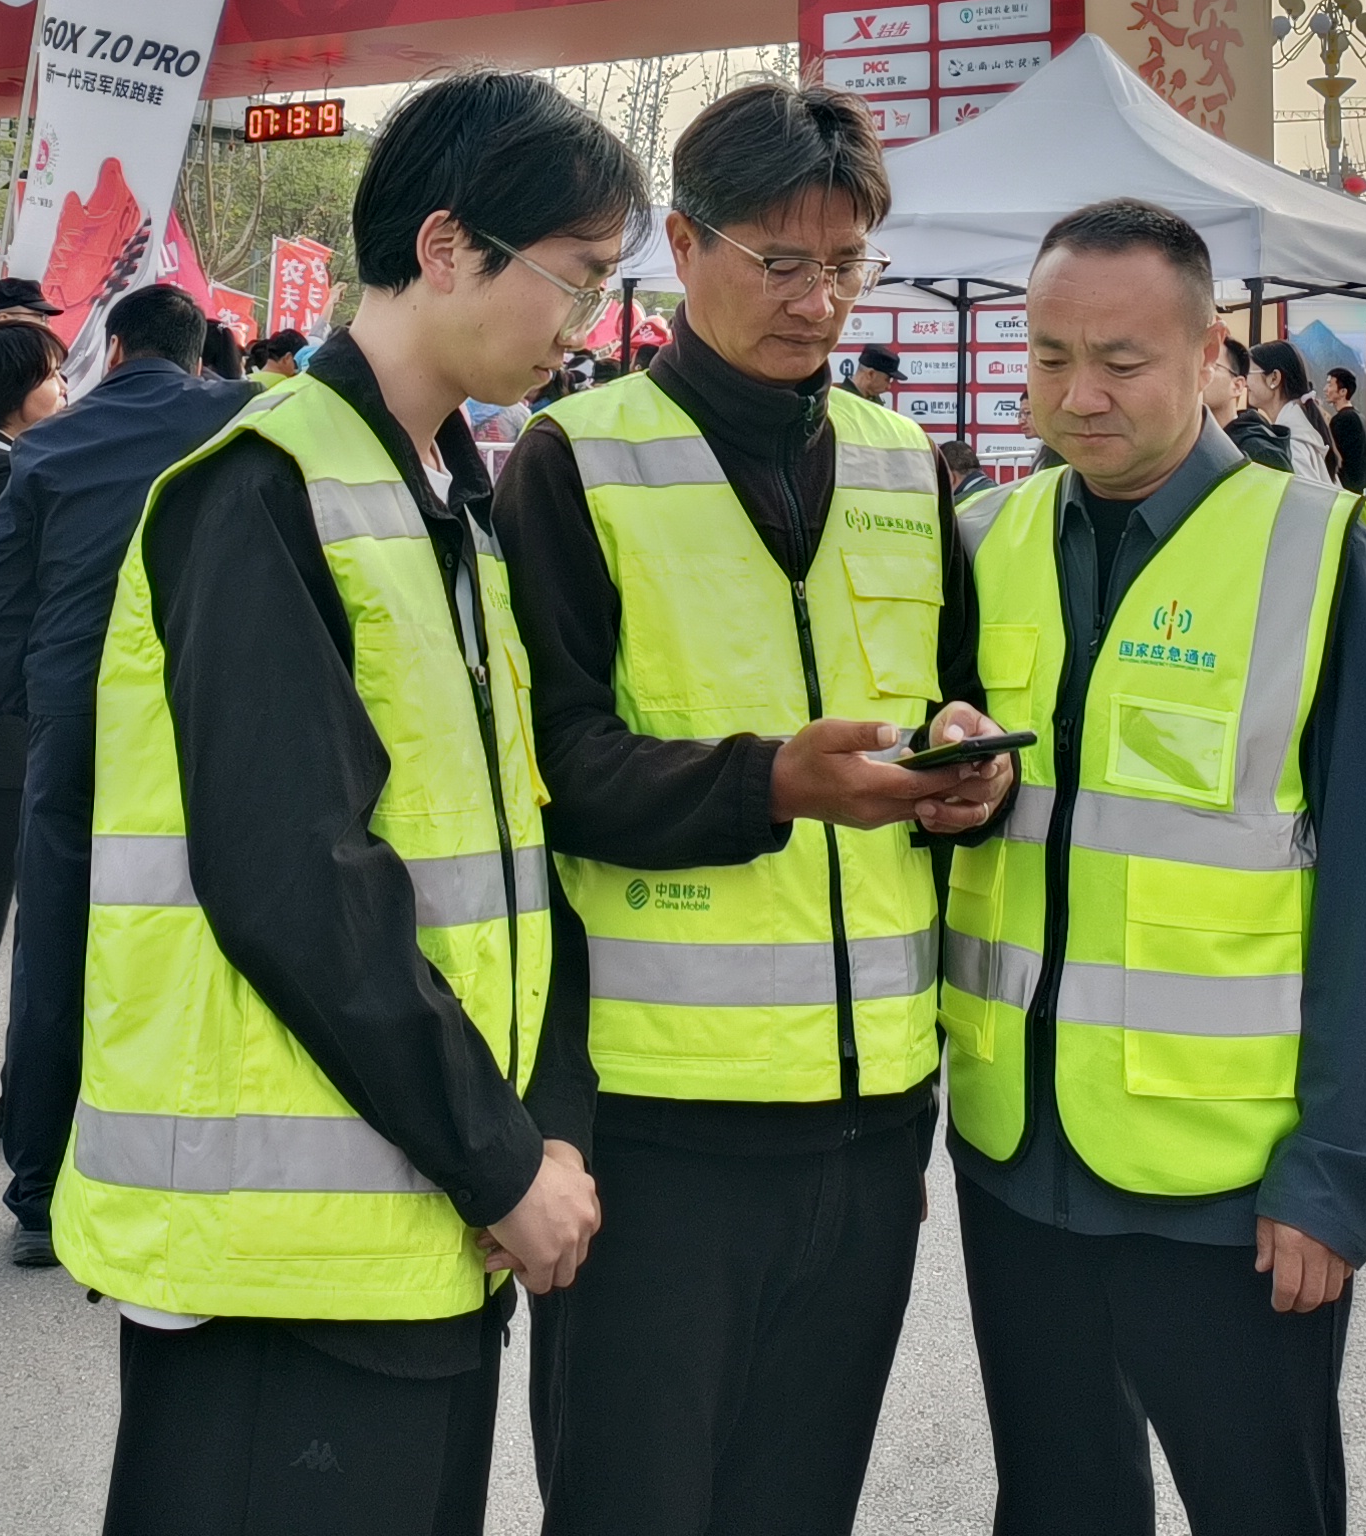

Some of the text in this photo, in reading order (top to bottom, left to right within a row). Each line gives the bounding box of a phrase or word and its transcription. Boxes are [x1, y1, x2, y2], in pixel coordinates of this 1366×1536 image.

[85, 29, 133, 64] 7.0
[132, 39, 201, 78] PRO
[863, 61, 889, 74] PICC
[844, 75, 907, 88] 中国人民保险
[248, 104, 337, 139] 07:13:19
[1119, 640, 1216, 668] 国家应急通信
[655, 882, 710, 900] 中国移动
[655, 898, 710, 911] China Mobile
